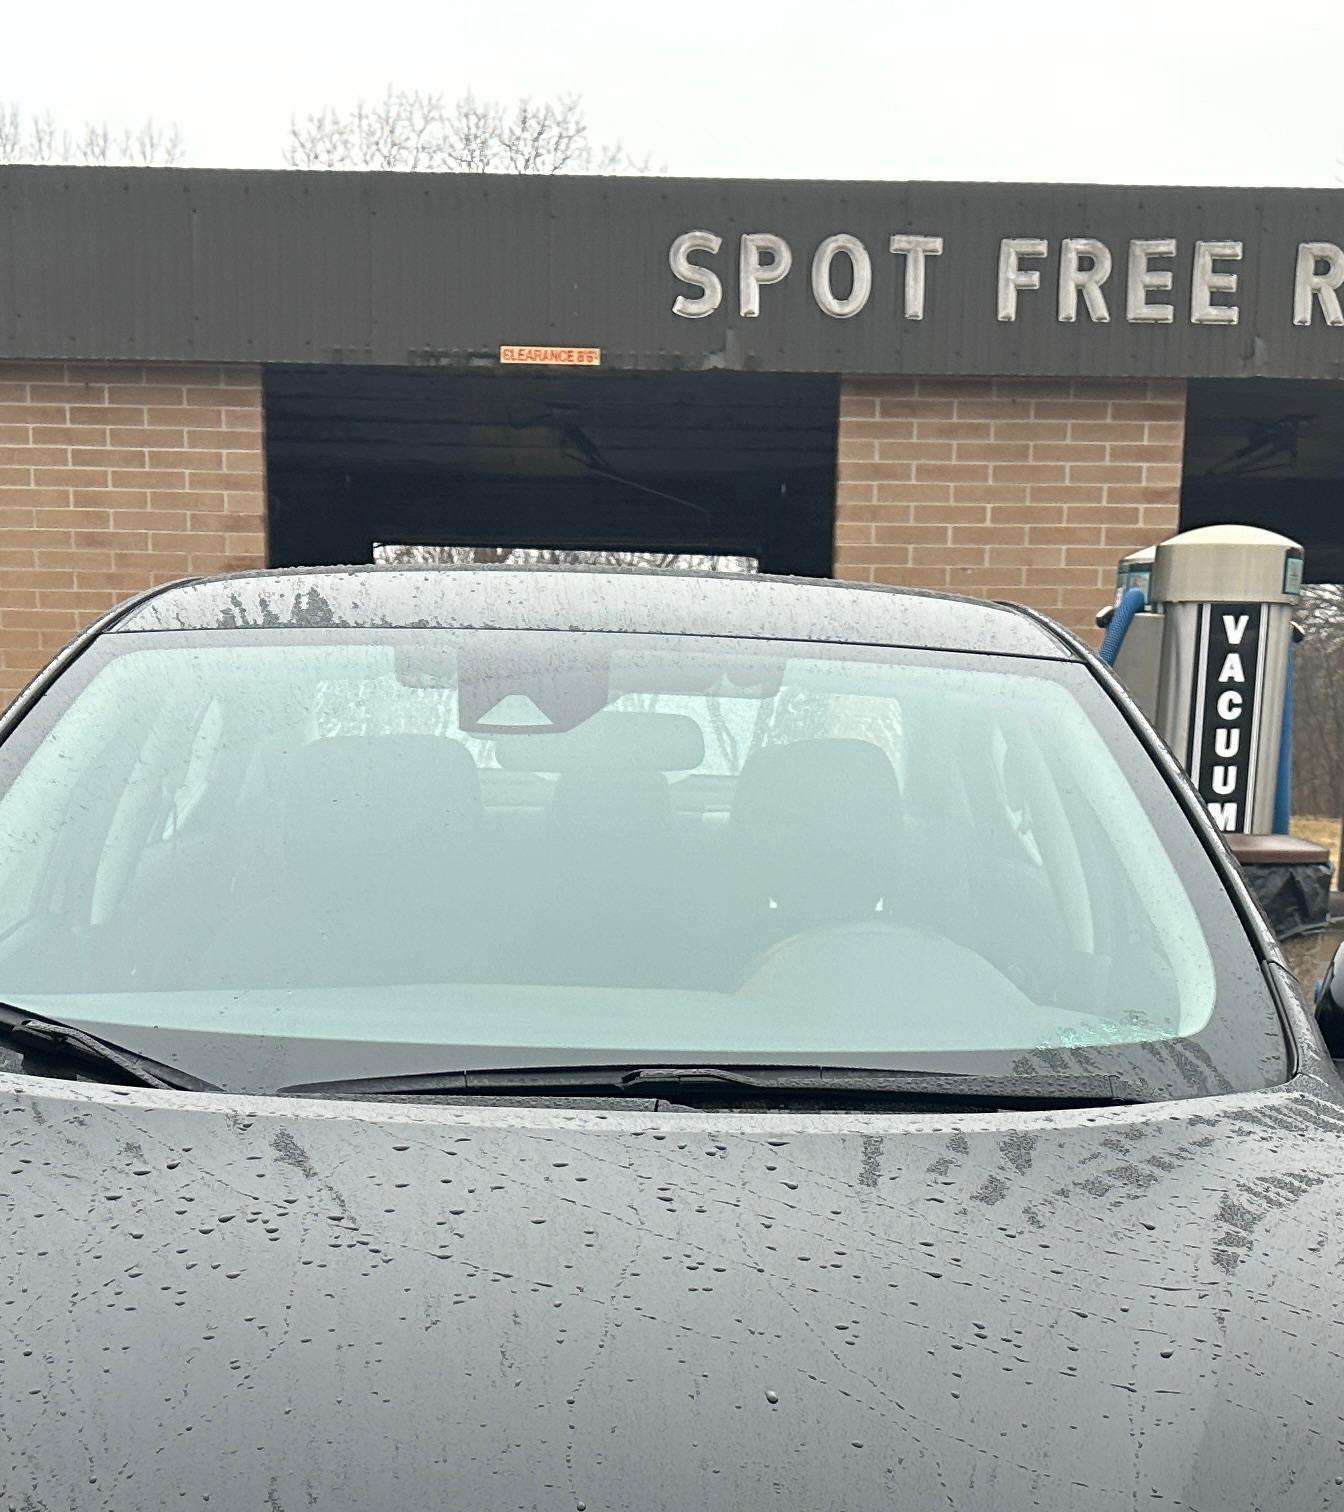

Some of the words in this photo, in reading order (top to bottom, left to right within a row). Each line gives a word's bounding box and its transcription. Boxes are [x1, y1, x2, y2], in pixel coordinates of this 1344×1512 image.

[668, 230, 944, 320] SPOT
[997, 237, 1244, 325] FREE
[502, 348, 574, 362] CLEARANCE
[1207, 615, 1250, 832] VACUUM
